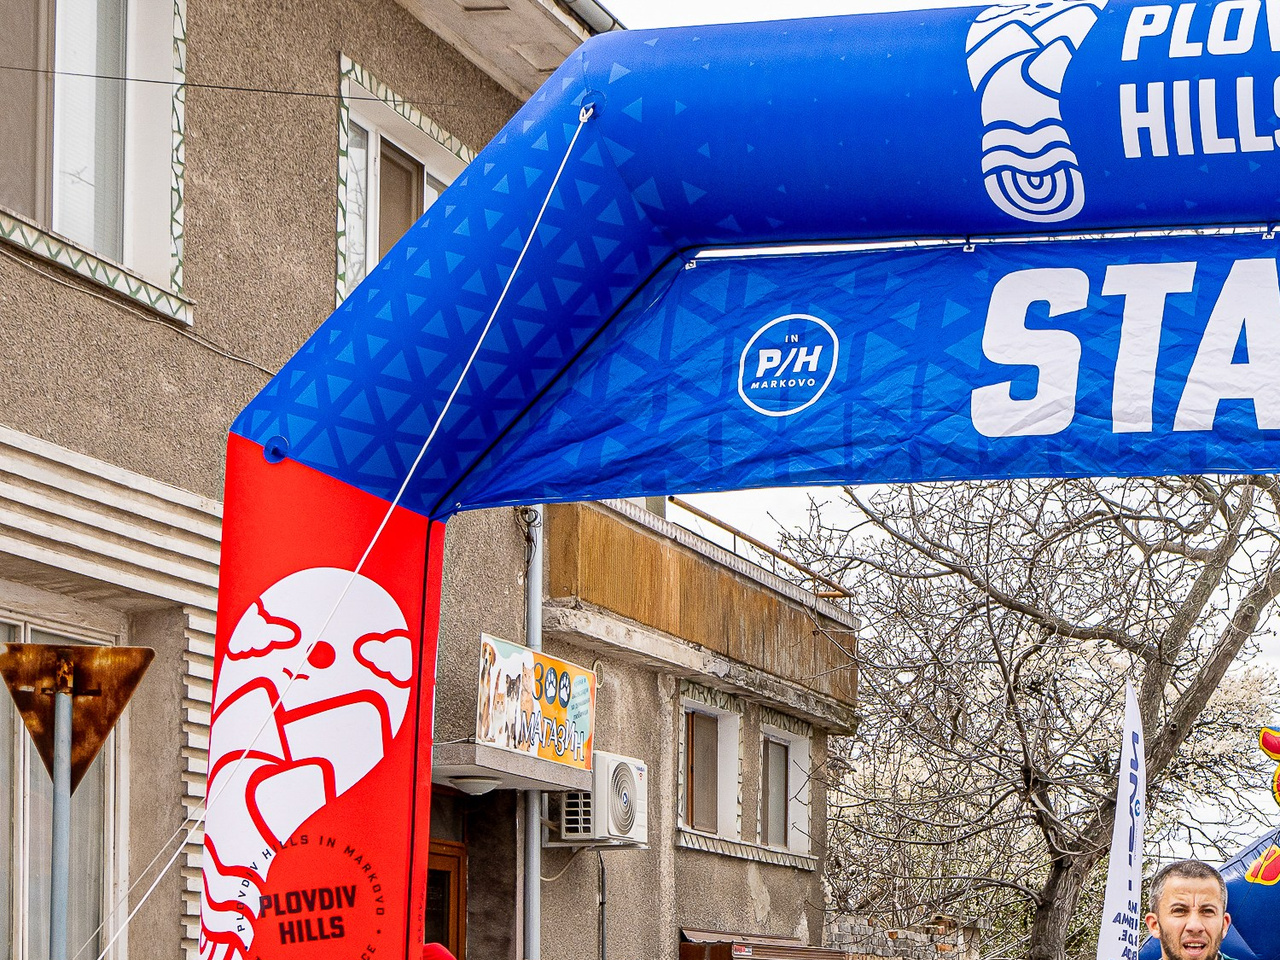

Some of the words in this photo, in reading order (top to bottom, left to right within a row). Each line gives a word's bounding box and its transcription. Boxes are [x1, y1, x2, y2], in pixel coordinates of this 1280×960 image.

[785, 334, 799, 343] IN
[756, 345, 823, 378] P/H
[750, 378, 816, 389] MARKOVO
[520, 710, 585, 762] МАГАЗИН
[236, 862, 258, 932] PLOVDIV
[262, 835, 309, 860] HILLS
[319, 836, 336, 847] IN
[344, 846, 385, 916] MARKOVO
[259, 885, 357, 918] PLOVDIV
[279, 916, 345, 945] HILLS
